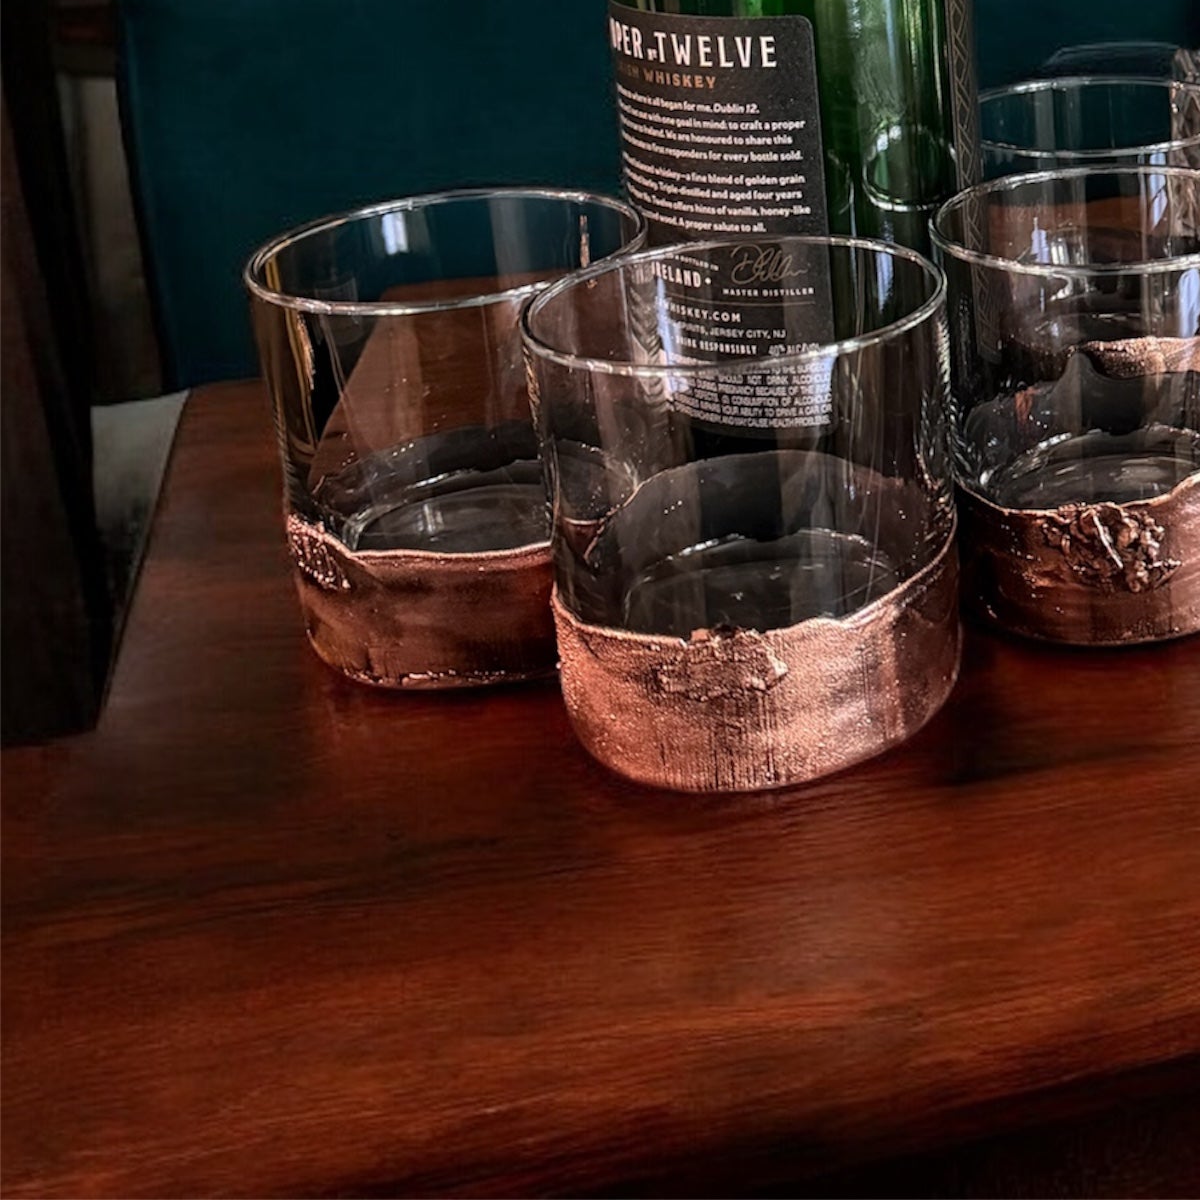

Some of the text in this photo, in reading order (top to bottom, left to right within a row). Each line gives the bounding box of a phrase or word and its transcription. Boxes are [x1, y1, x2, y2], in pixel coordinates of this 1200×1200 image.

[653, 31, 777, 69] TWELVE
[643, 67, 716, 89] WHISKEY
[713, 103, 745, 113] Dublin
[745, 103, 760, 114] 12.
[728, 121, 739, 131] to
[740, 120, 763, 131] craft
[763, 122, 771, 131] a
[771, 121, 806, 132] proper
[690, 132, 733, 145] honoured
[733, 136, 744, 146] to
[745, 135, 773, 146] share
[773, 134, 793, 145] this
[664, 147, 708, 160] responders
[708, 150, 722, 161] for
[723, 153, 750, 164] every
[750, 151, 779, 162] bottle
[779, 150, 804, 161] sold.
[707, 173, 734, 185] blend
[734, 174, 745, 185] of
[745, 174, 778, 187] golden
[779, 174, 806, 187] grain
[711, 189, 729, 199] and
[729, 189, 753, 202] aged
[753, 189, 774, 201] four
[774, 190, 803, 202] years
[716, 204, 728, 215] of
[760, 205, 812, 218] honey-like
[685, 219, 713, 232] proper
[713, 221, 741, 232] salute
[741, 224, 752, 232] to
[752, 222, 767, 232] all.
[723, 287, 815, 298] MASTER DISTILLER
[709, 326, 744, 339] JERSEY
[745, 329, 771, 340] CITY,
[772, 329, 787, 339] NJ
[700, 340, 757, 356] RESPONSIBLY
